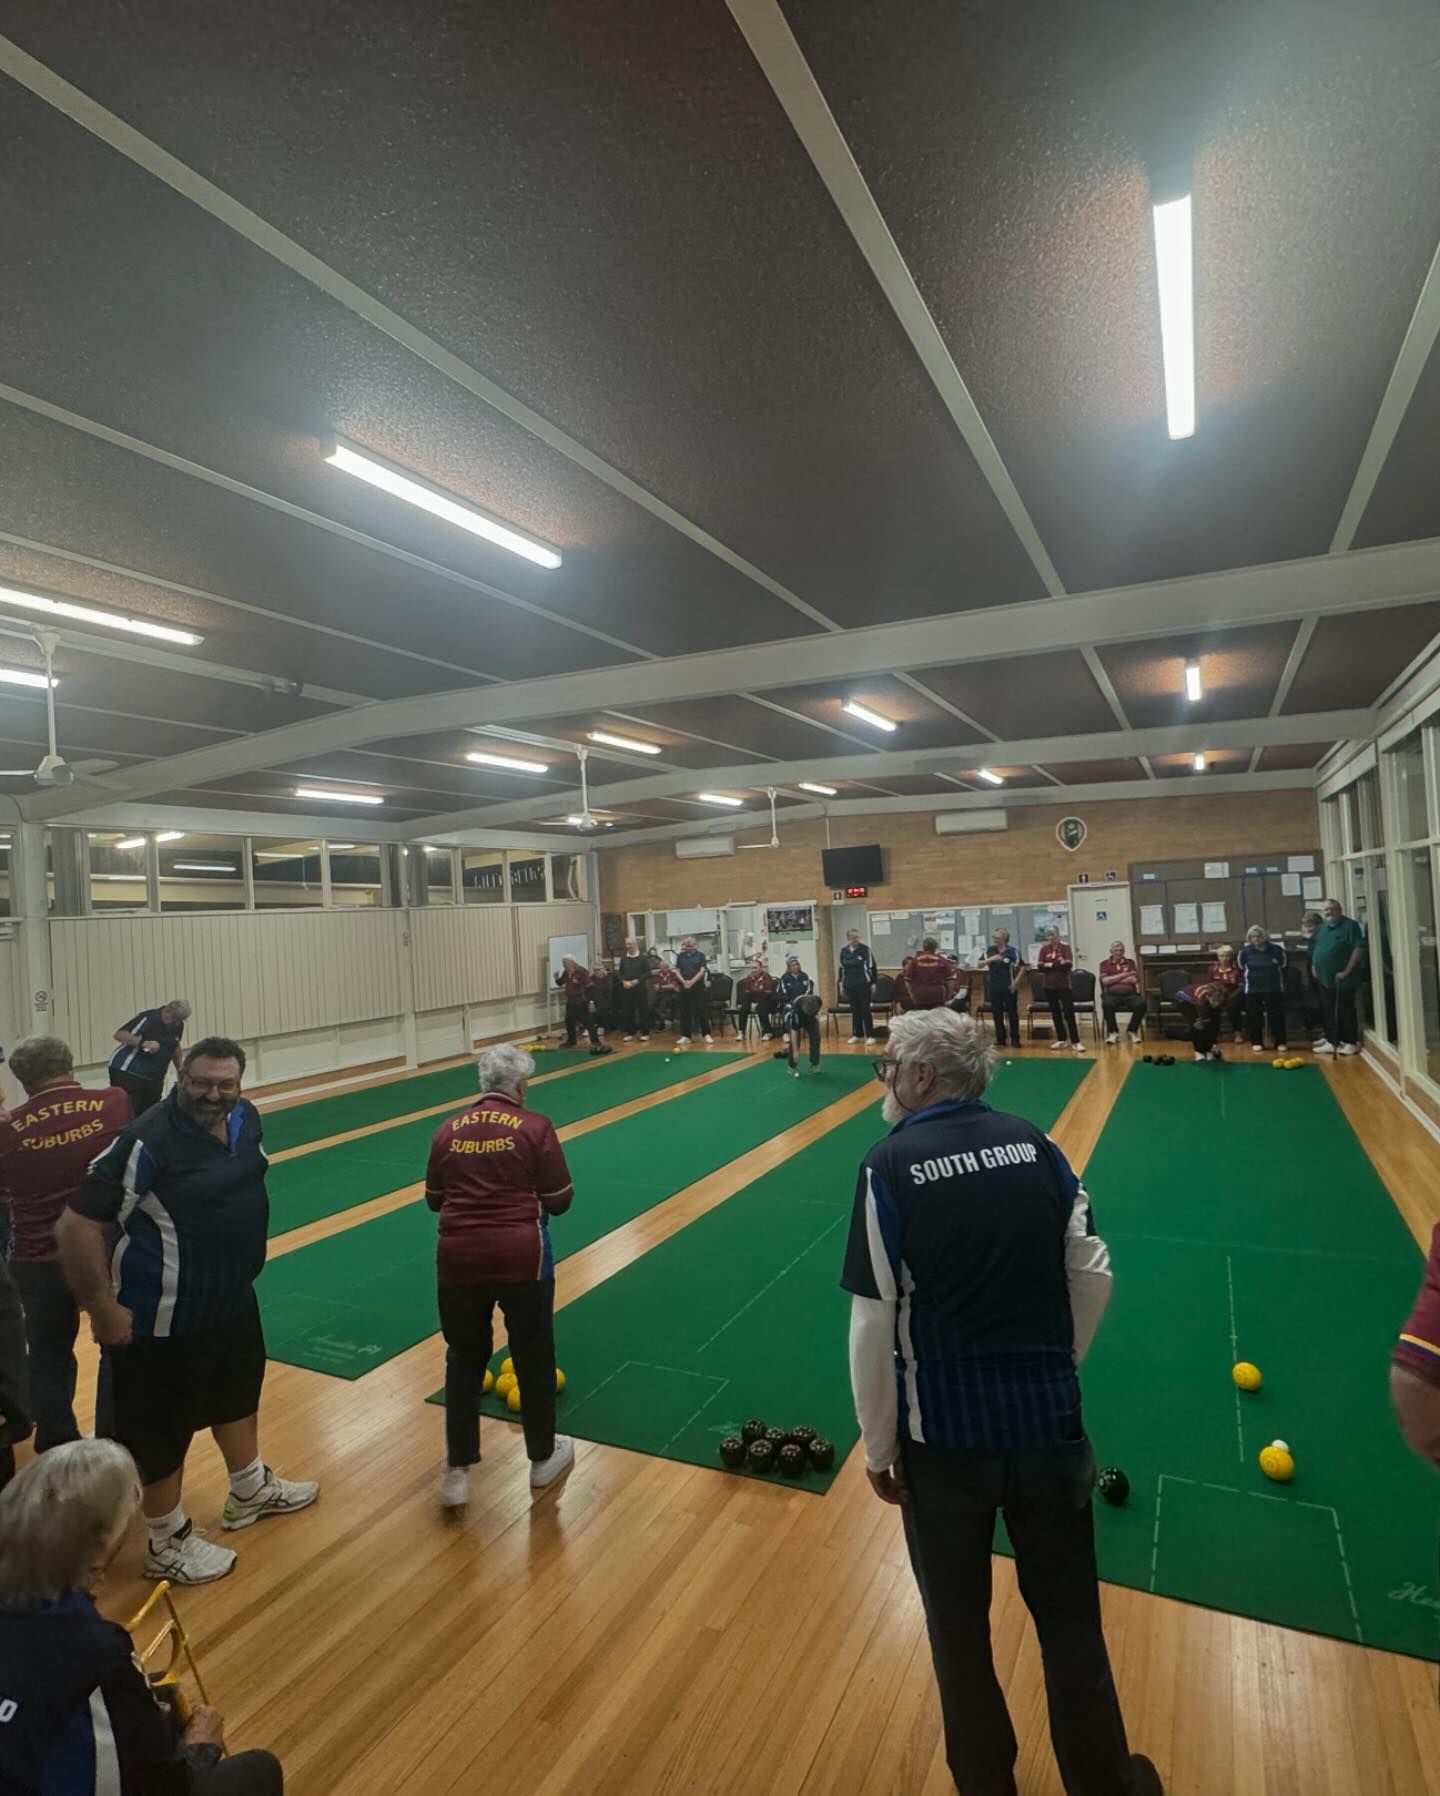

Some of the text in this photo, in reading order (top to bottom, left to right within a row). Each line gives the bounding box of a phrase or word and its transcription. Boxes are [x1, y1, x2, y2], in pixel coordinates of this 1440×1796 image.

[11, 1100, 104, 1132] EASTERN
[452, 1111, 524, 1131] EASTERN
[449, 1136, 516, 1154] SUBURBS
[910, 1143, 1037, 1185] SOUTH GROUP
